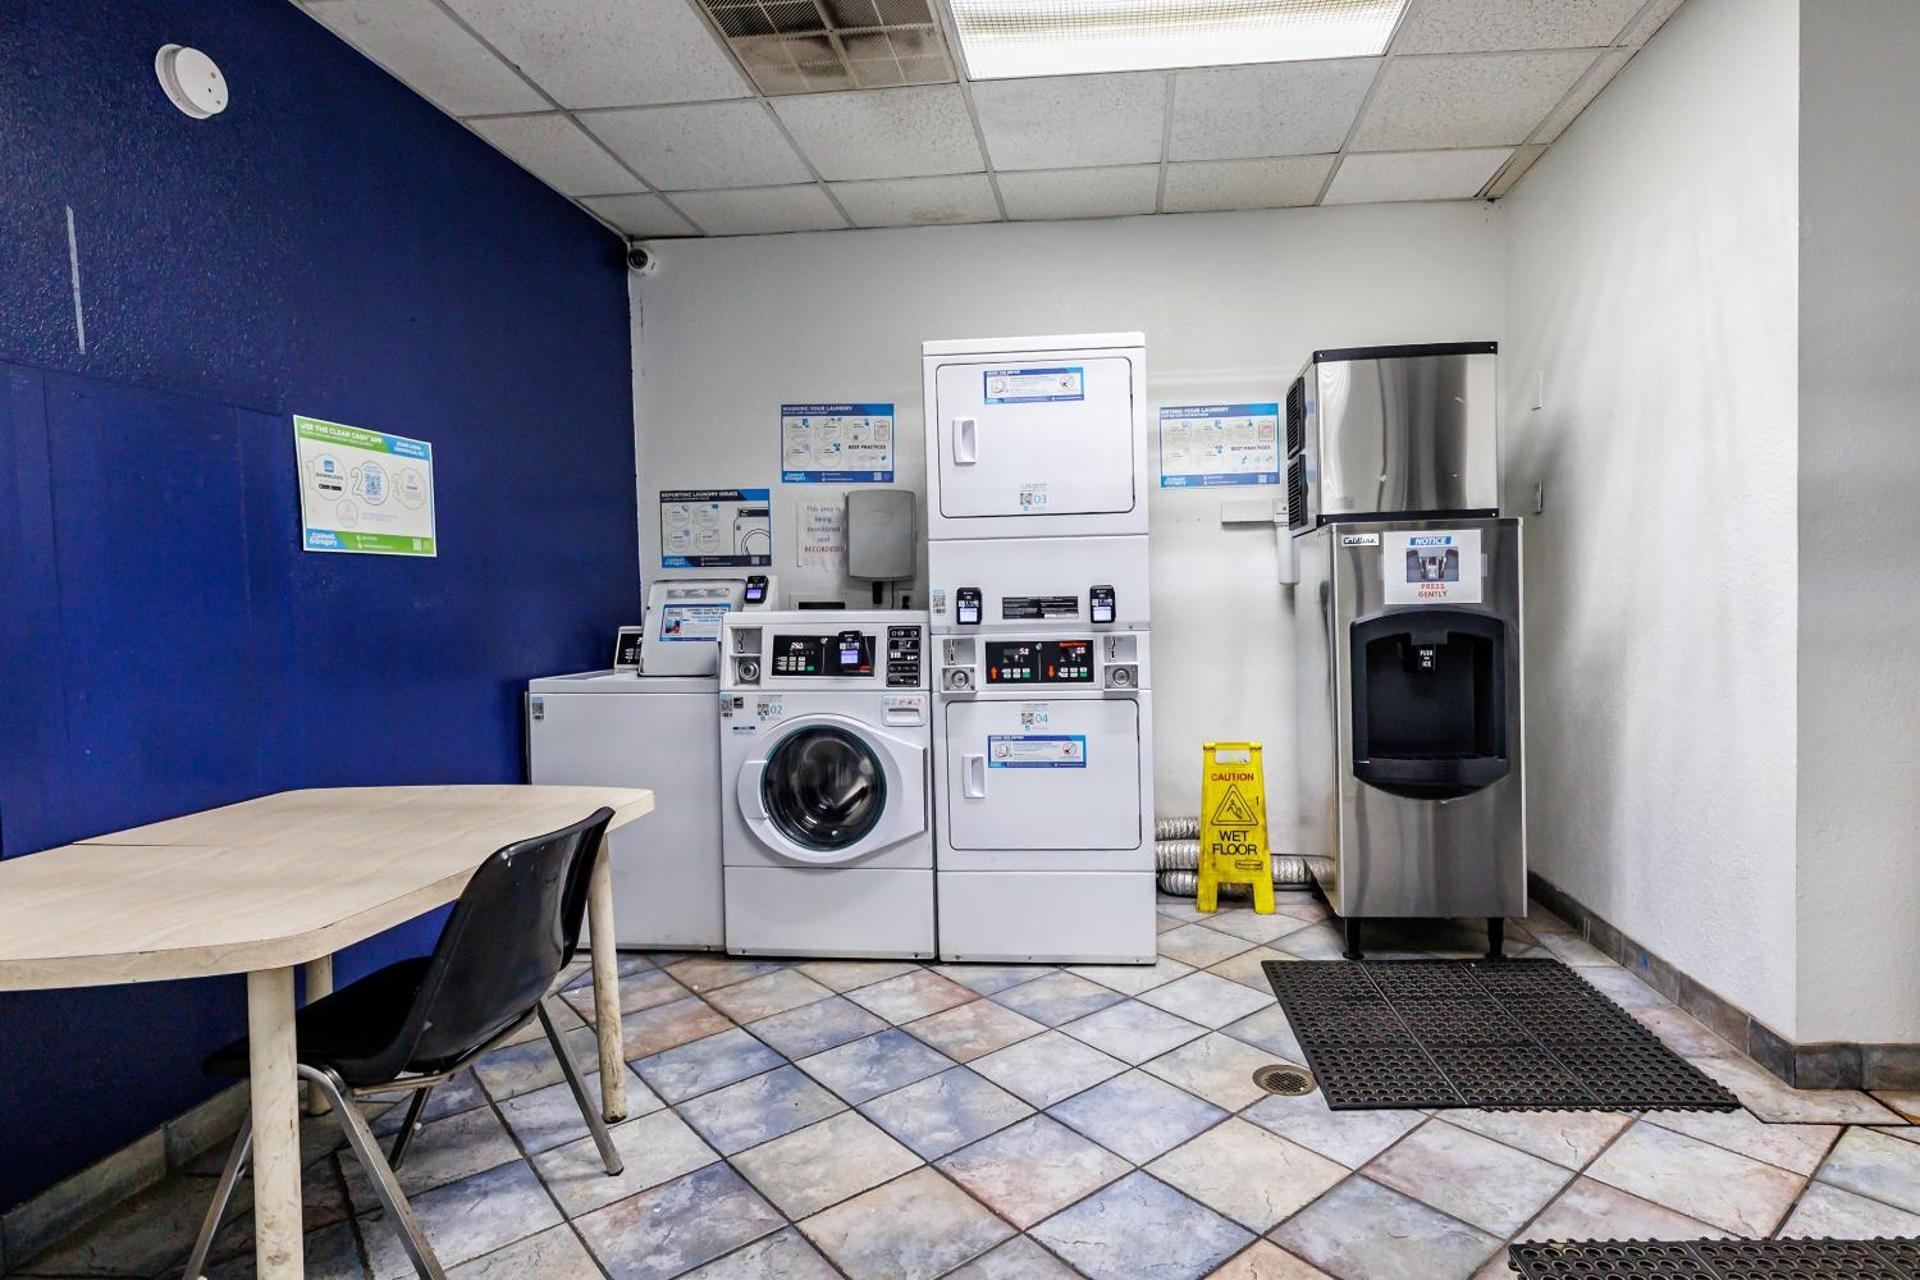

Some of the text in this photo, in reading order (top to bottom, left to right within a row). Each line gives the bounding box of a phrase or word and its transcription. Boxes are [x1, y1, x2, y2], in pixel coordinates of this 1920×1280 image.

[1415, 537, 1447, 546] NOTICE
[1418, 590, 1447, 598] GENTLY
[770, 704, 784, 714] 02
[1211, 773, 1254, 782] CAUTION
[1219, 830, 1249, 842] WET
[1212, 843, 1257, 856] FLOOR
